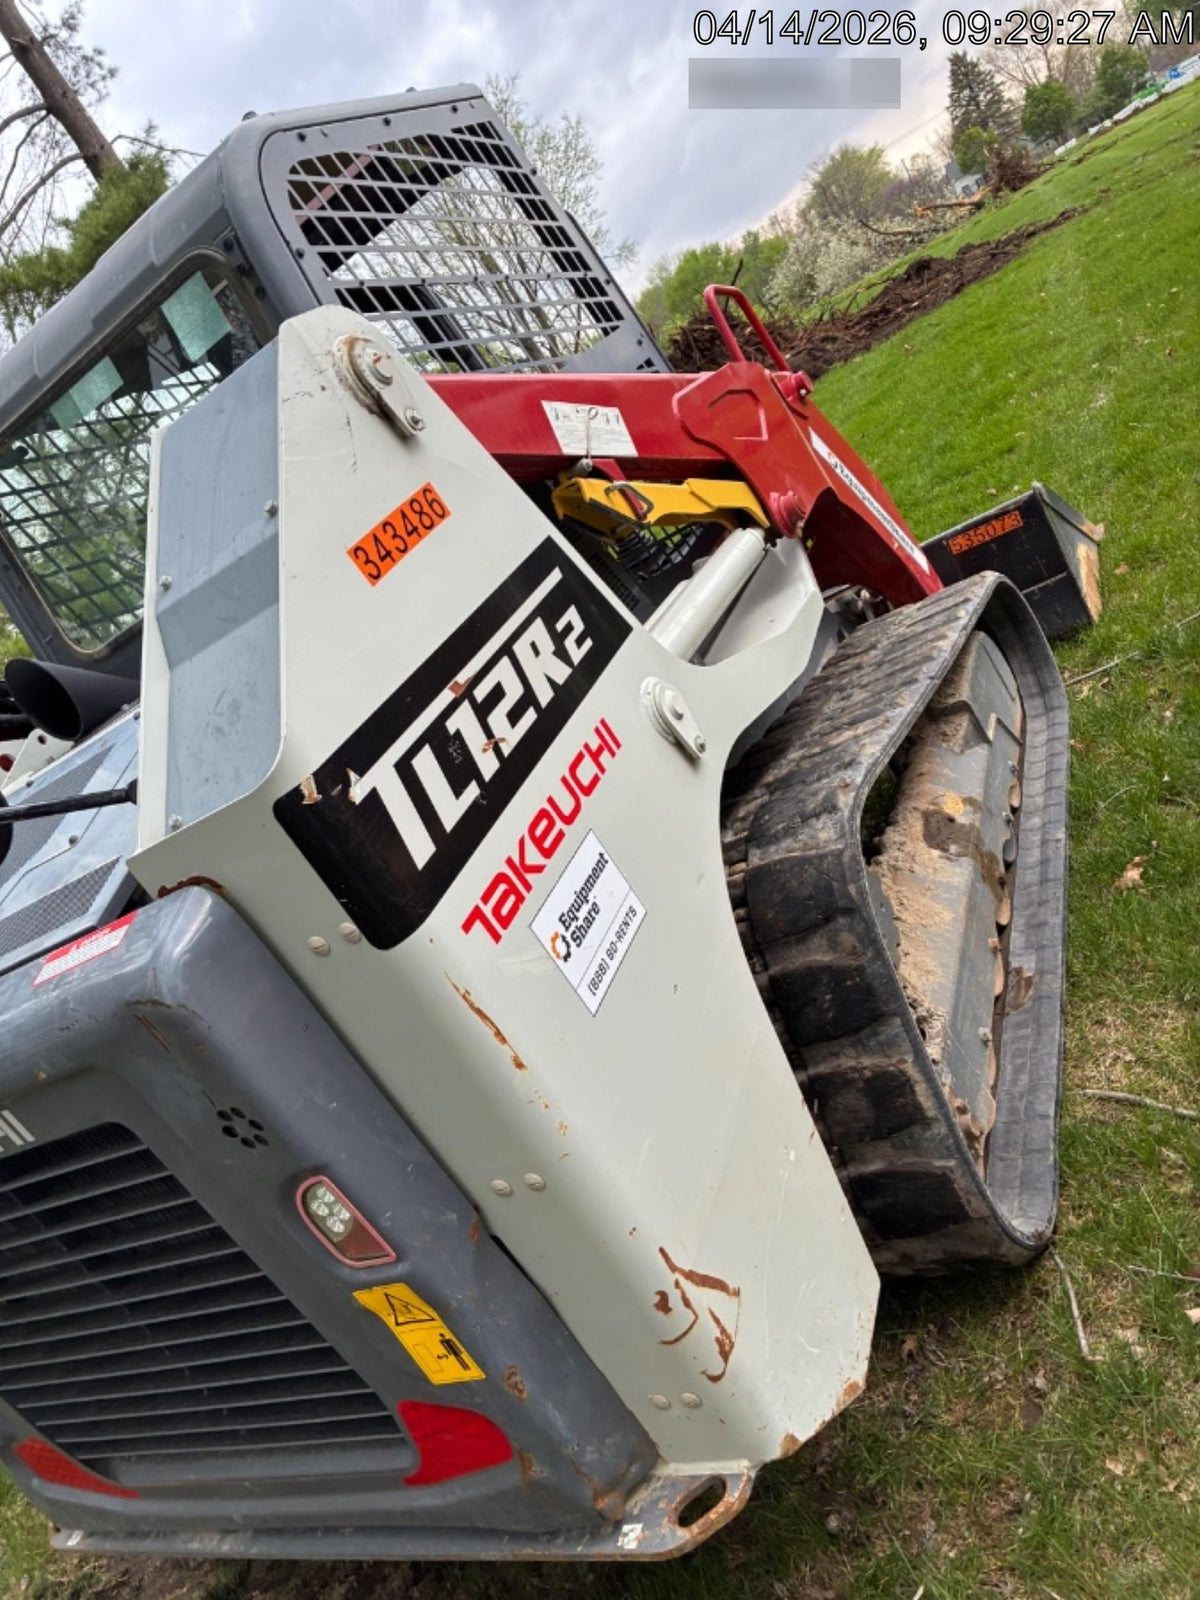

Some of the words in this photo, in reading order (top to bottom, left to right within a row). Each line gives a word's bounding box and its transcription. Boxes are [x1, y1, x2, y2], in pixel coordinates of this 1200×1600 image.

[353, 488, 446, 580] 343486
[951, 511, 1021, 552] 535073
[558, 852, 609, 932] Equipment
[570, 901, 601, 948] Share
